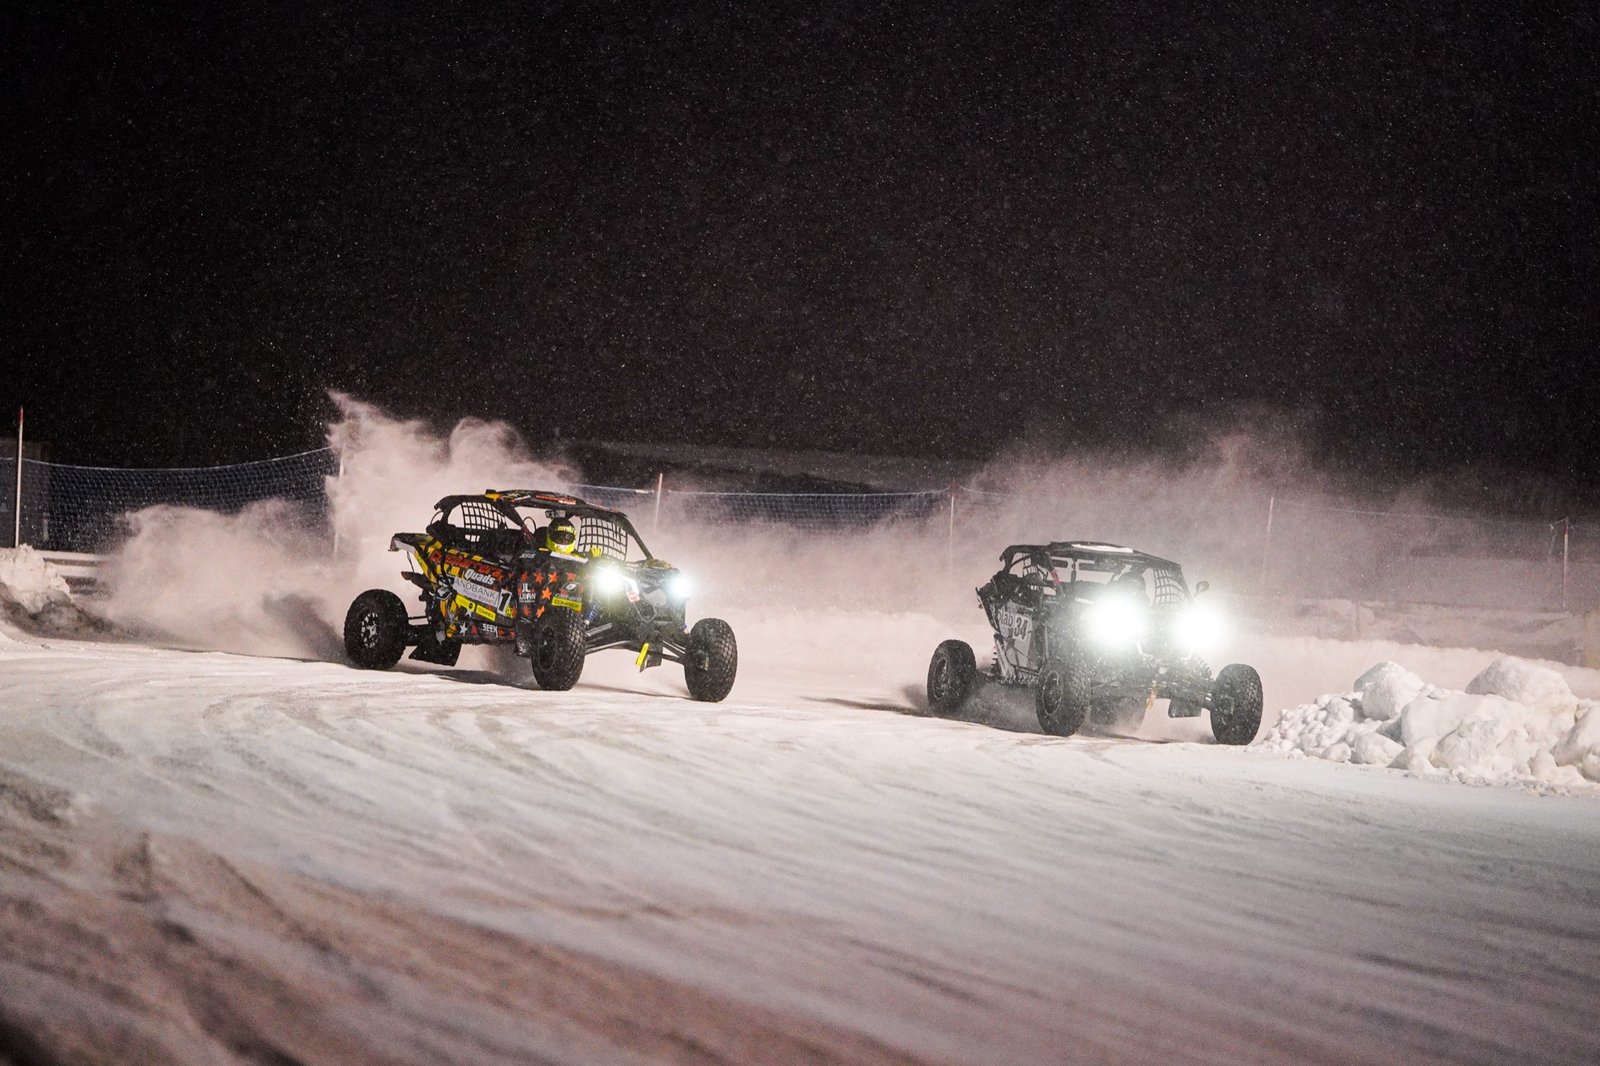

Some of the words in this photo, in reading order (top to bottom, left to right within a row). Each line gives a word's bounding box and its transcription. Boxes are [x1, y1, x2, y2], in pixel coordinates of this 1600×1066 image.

[464, 568, 496, 585] Quads
[455, 578, 496, 599] ANDBANK
[499, 593, 510, 612] 1
[1014, 616, 1028, 640] 34
